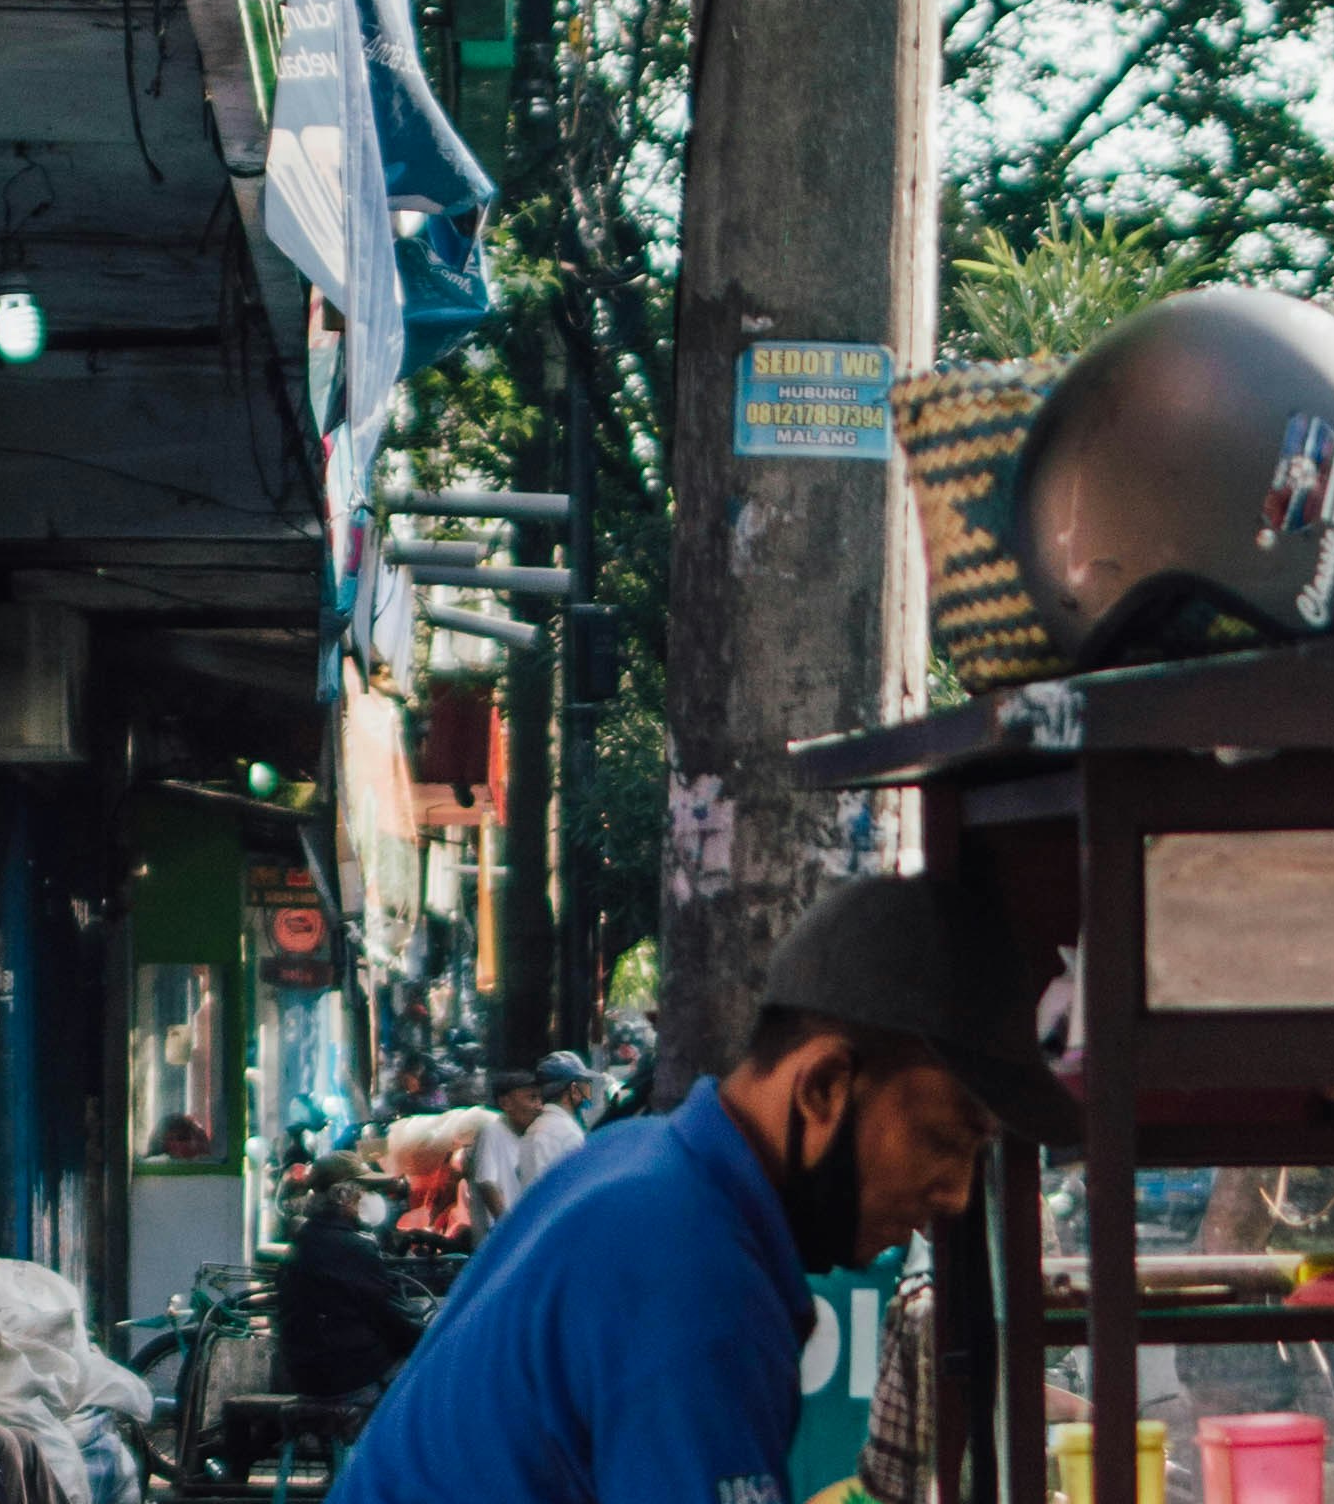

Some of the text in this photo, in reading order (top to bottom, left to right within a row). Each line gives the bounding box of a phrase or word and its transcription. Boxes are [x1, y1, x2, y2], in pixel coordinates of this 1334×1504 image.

[754, 349, 882, 378] SEDOT WC
[778, 386, 857, 401] HUBUNGI
[776, 429, 857, 445] MALANG
